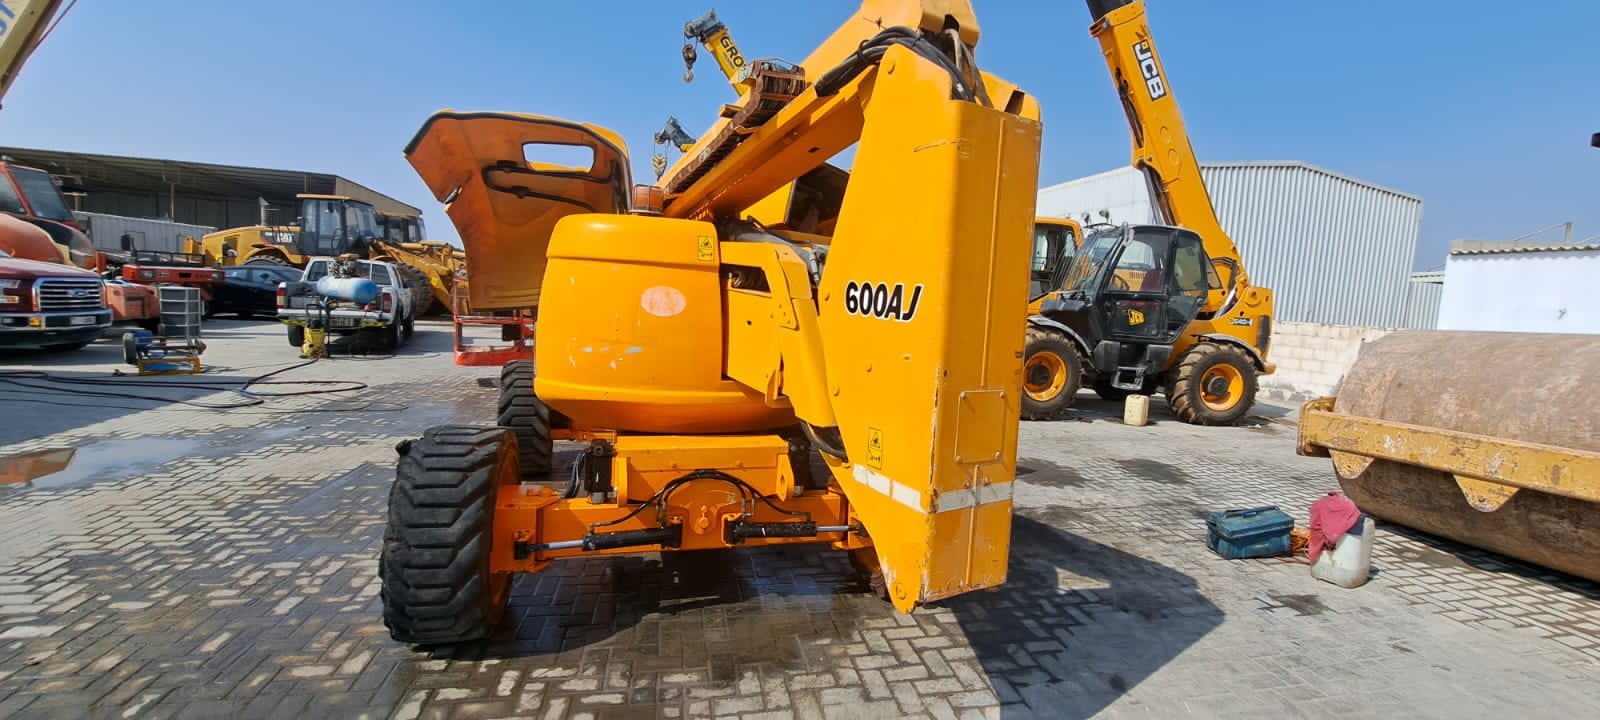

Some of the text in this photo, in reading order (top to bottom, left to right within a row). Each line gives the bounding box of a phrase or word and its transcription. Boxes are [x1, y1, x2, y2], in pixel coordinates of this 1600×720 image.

[720, 36, 746, 69] GRO
[1133, 40, 1166, 100] JCB
[845, 281, 922, 321] 600AJ
